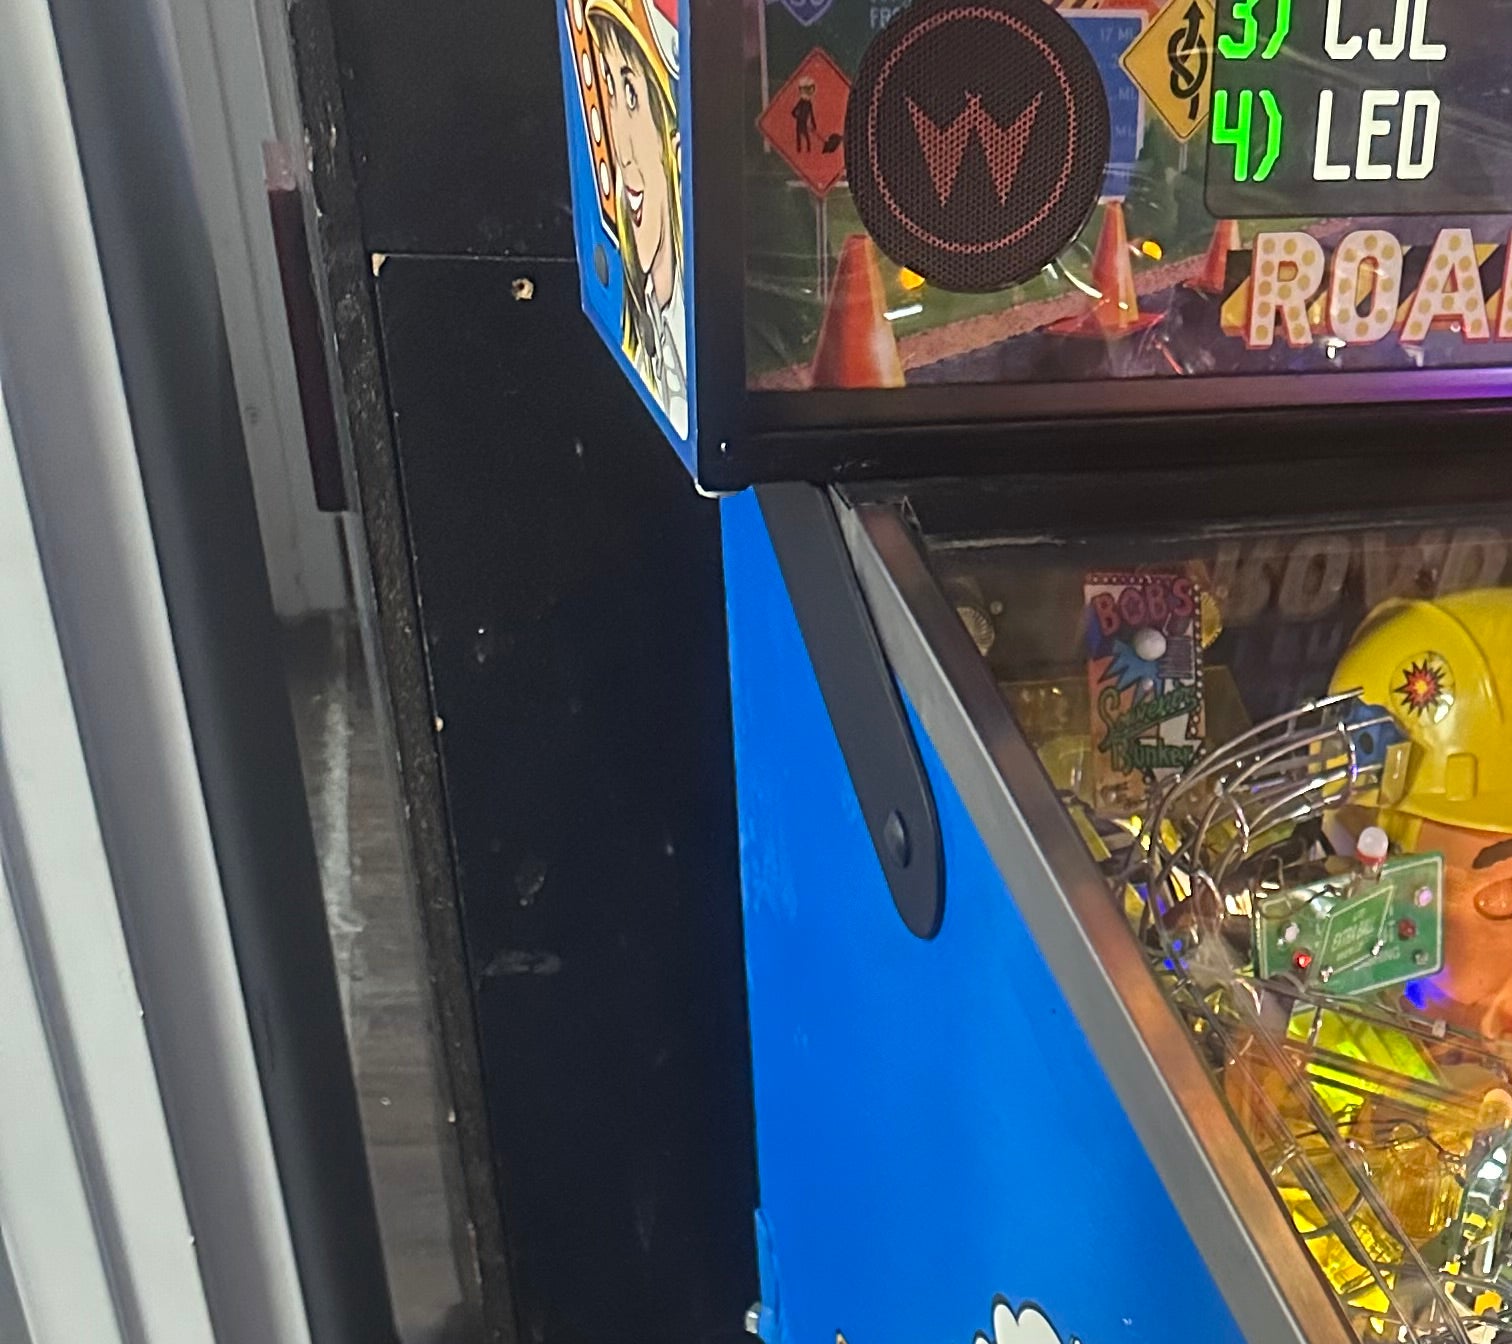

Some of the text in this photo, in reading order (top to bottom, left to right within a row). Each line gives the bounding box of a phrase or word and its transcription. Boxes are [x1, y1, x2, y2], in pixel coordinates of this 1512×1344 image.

[1217, 0, 1291, 60] 3)
[1211, 90, 1283, 181] 4)
[1313, 90, 1440, 180] LED
